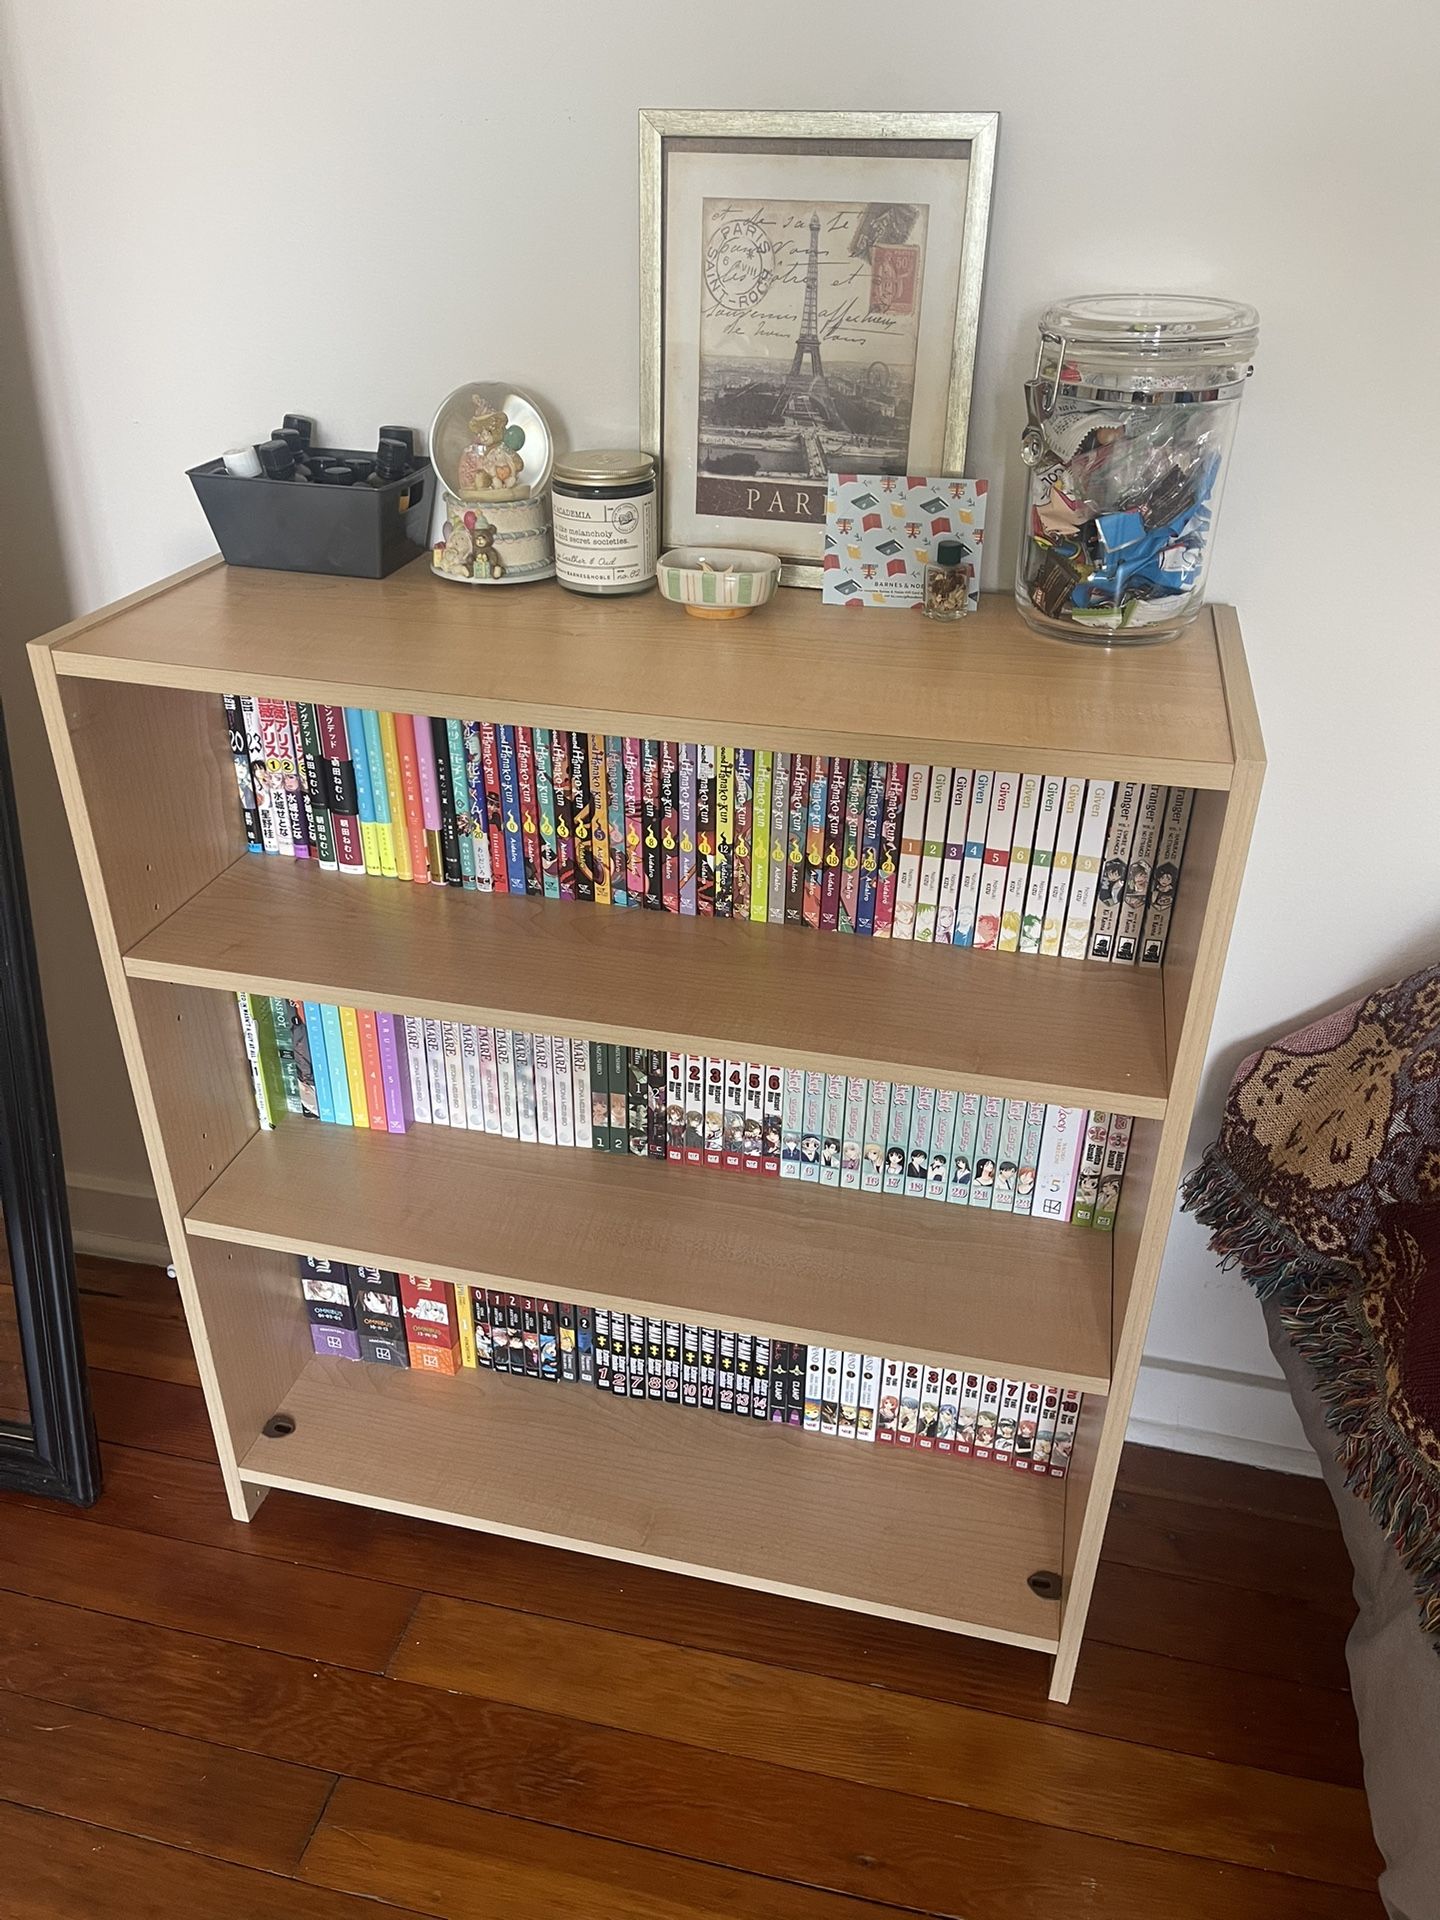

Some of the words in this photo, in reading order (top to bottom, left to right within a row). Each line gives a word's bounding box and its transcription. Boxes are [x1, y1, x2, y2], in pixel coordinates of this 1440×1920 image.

[746, 487, 828, 516] PARI
[568, 529, 613, 539] melancholy
[569, 536, 591, 546] secret
[874, 581, 903, 589] BARNES
[229, 729, 244, 753] 20
[269, 760, 276, 770] 1
[283, 762, 291, 771] 2
[911, 771, 923, 801] Given
[934, 774, 946, 803] Given
[954, 776, 967, 806] Given
[976, 774, 988, 804] Given
[997, 782, 1010, 811] Given
[1022, 779, 1036, 808] Given
[1045, 782, 1058, 812] Given
[1066, 784, 1080, 813] Given
[1091, 788, 1106, 817] Given
[1121, 782, 1137, 820] tranger
[908, 842, 913, 852] 1
[930, 845, 936, 854] 2
[950, 847, 957, 857] 3
[971, 846, 976, 855] 4
[992, 854, 999, 863] 5
[1017, 851, 1024, 860] 6
[1040, 854, 1046, 863] 7
[1060, 856, 1067, 865] 8
[1084, 860, 1091, 869] 9
[274, 997, 287, 1028] NSPOT
[670, 1065, 679, 1080] 1
[689, 1065, 700, 1081] 2
[710, 1068, 721, 1083] 3
[729, 1070, 741, 1085] 4
[749, 1073, 760, 1088] 5
[768, 1075, 780, 1090] 6
[636, 1083, 641, 1094] 1
[653, 1088, 660, 1099] 2
[596, 1138, 604, 1147] 1
[615, 1139, 622, 1149] 2
[1050, 1179, 1061, 1192] 5
[475, 1289, 482, 1300] 0
[495, 1295, 500, 1305] 1
[509, 1296, 516, 1306] 2
[525, 1300, 531, 1310] 3
[542, 1303, 549, 1313] 4
[564, 1318, 568, 1326] 1
[582, 1320, 587, 1328] 2
[599, 1367, 608, 1379] 1
[888, 1364, 896, 1376] 1
[907, 1366, 918, 1379] 2
[612, 1374, 626, 1386] 2
[631, 1376, 644, 1388] 7
[648, 1377, 661, 1389] 8
[928, 1371, 939, 1384] 3
[946, 1372, 957, 1385] 4
[966, 1375, 978, 1388] 5
[665, 1379, 678, 1391] 9
[683, 1384, 697, 1396] 10
[986, 1380, 998, 1393] 6
[1007, 1384, 1018, 1397] 7
[702, 1385, 714, 1398] 11
[720, 1390, 734, 1403] 12
[1027, 1390, 1038, 1403] 8
[736, 1393, 749, 1406] 13
[754, 1397, 767, 1409] 14
[1045, 1396, 1057, 1408] 9
[1062, 1400, 1078, 1413] 10
